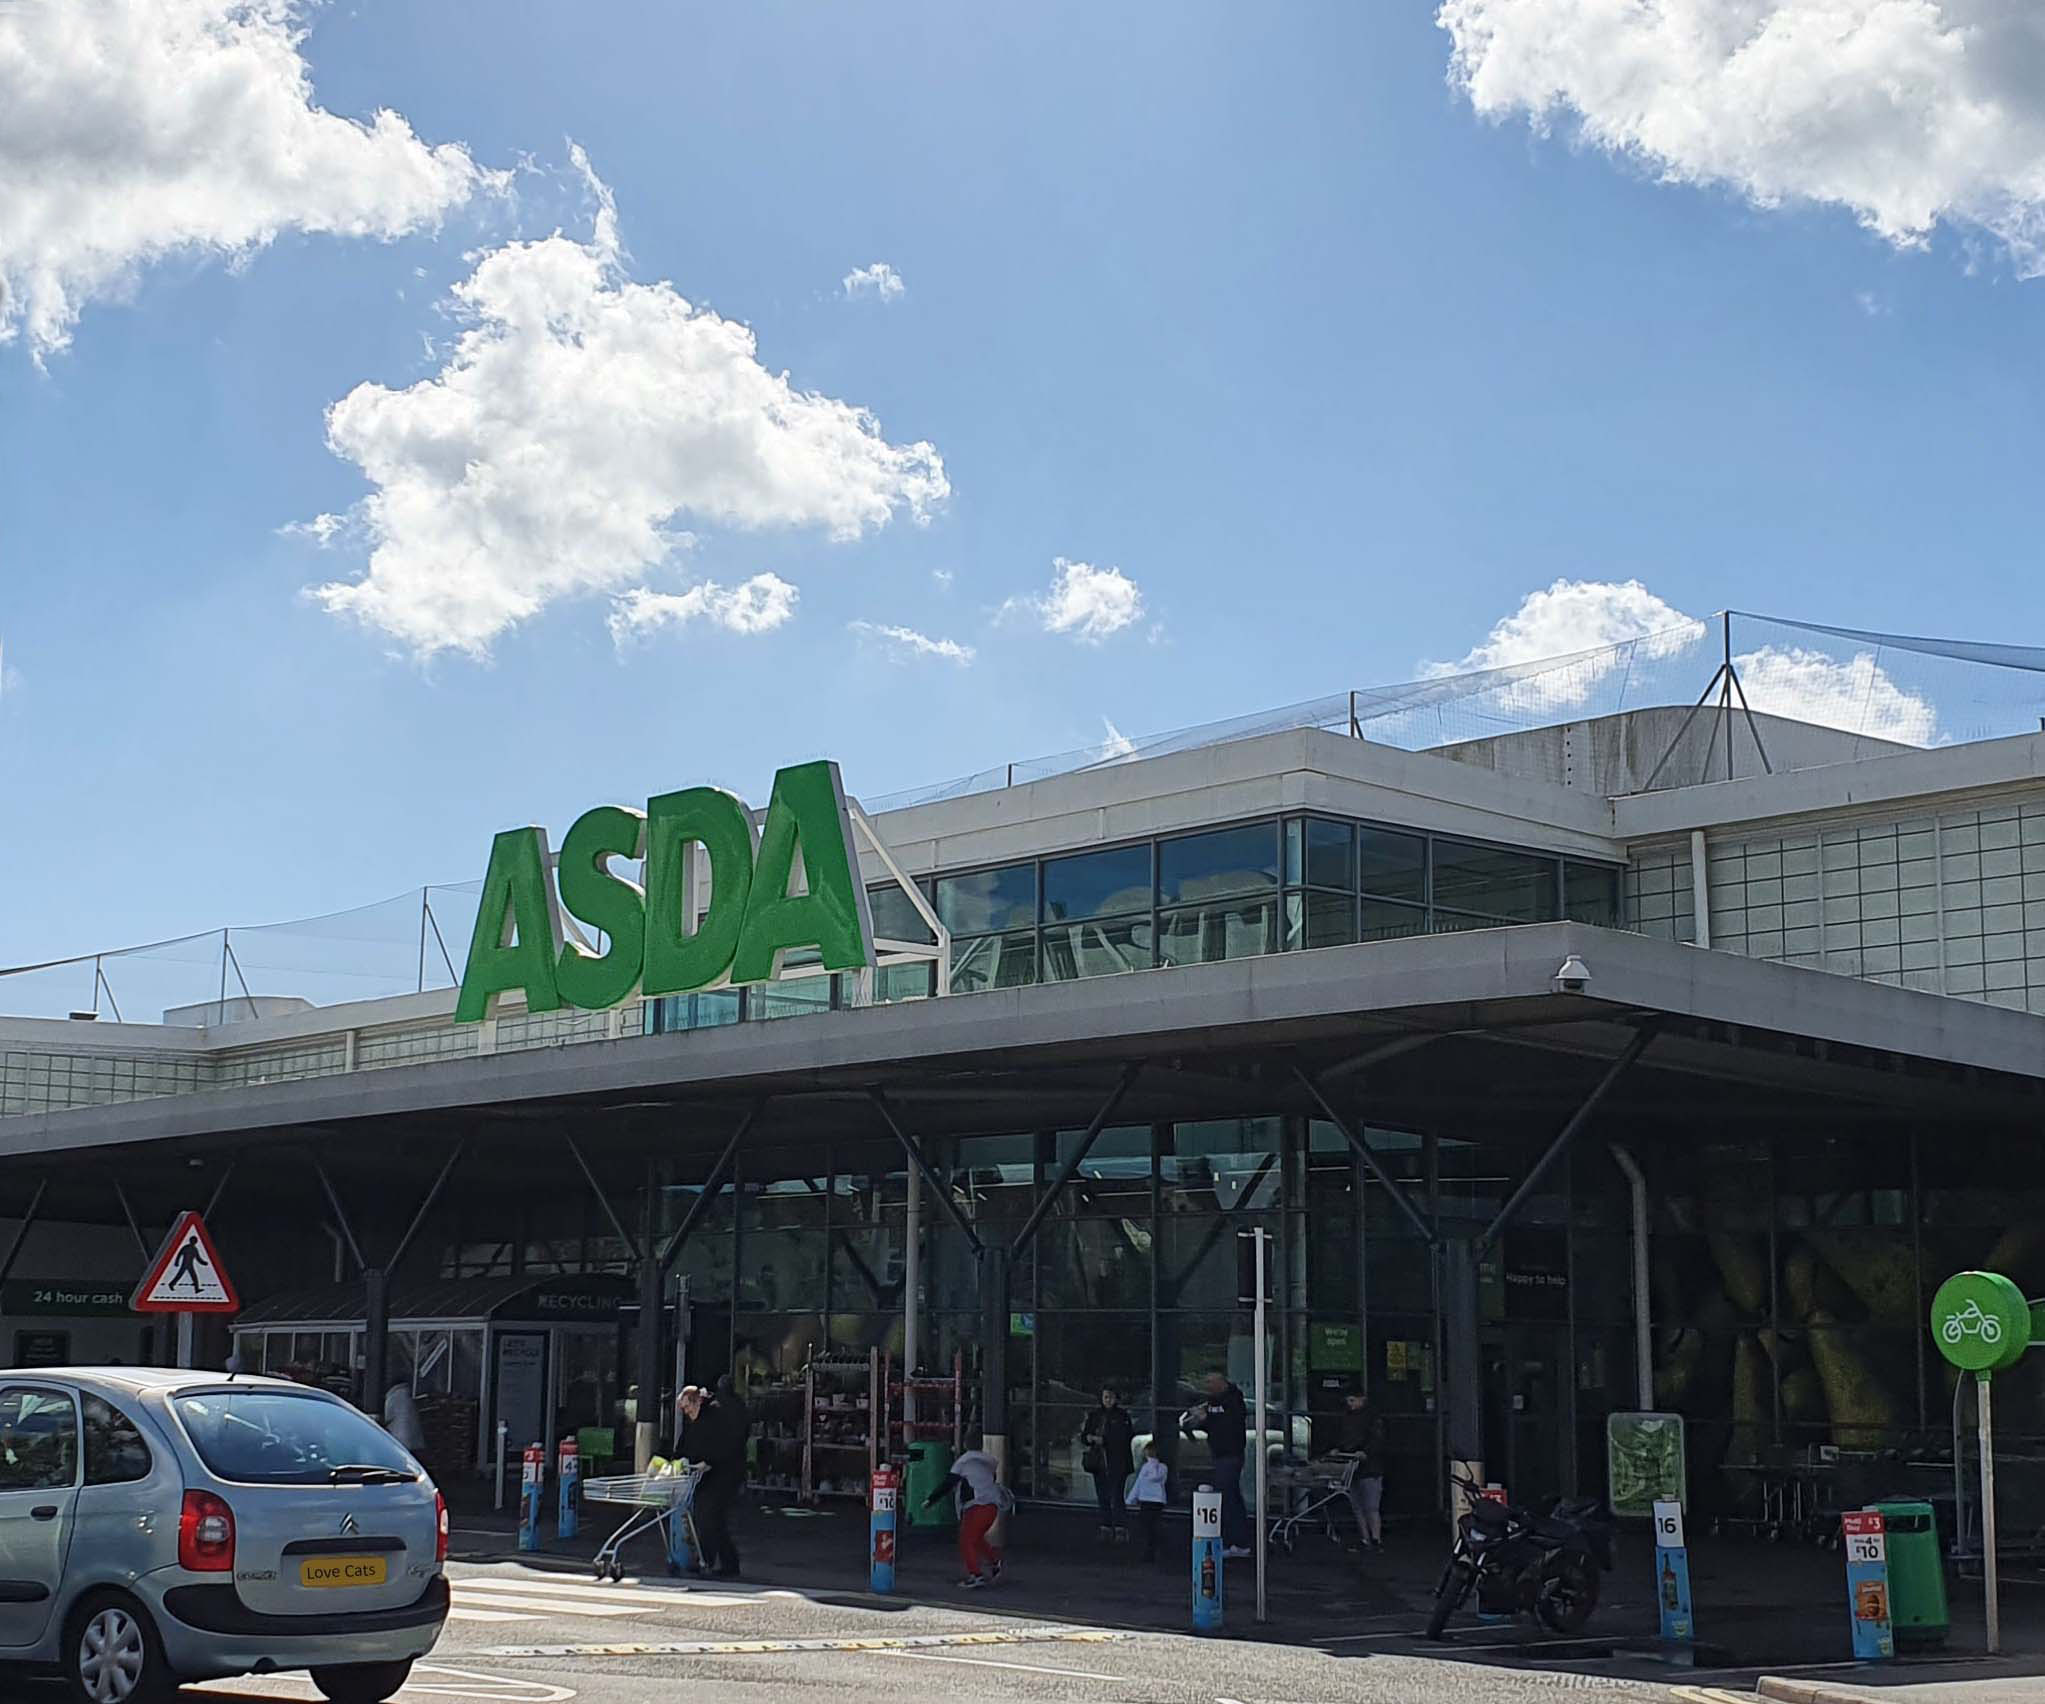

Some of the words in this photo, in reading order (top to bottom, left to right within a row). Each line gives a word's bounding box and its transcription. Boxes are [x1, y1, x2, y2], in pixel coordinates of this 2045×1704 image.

[454, 760, 872, 1023] ASDA
[33, 1290, 52, 1303] 24
[56, 1292, 89, 1304] hour
[91, 1293, 123, 1304] cash
[1658, 1517, 1677, 1534] 16
[306, 1565, 341, 1580] Love
[344, 1563, 376, 1578] Cats
